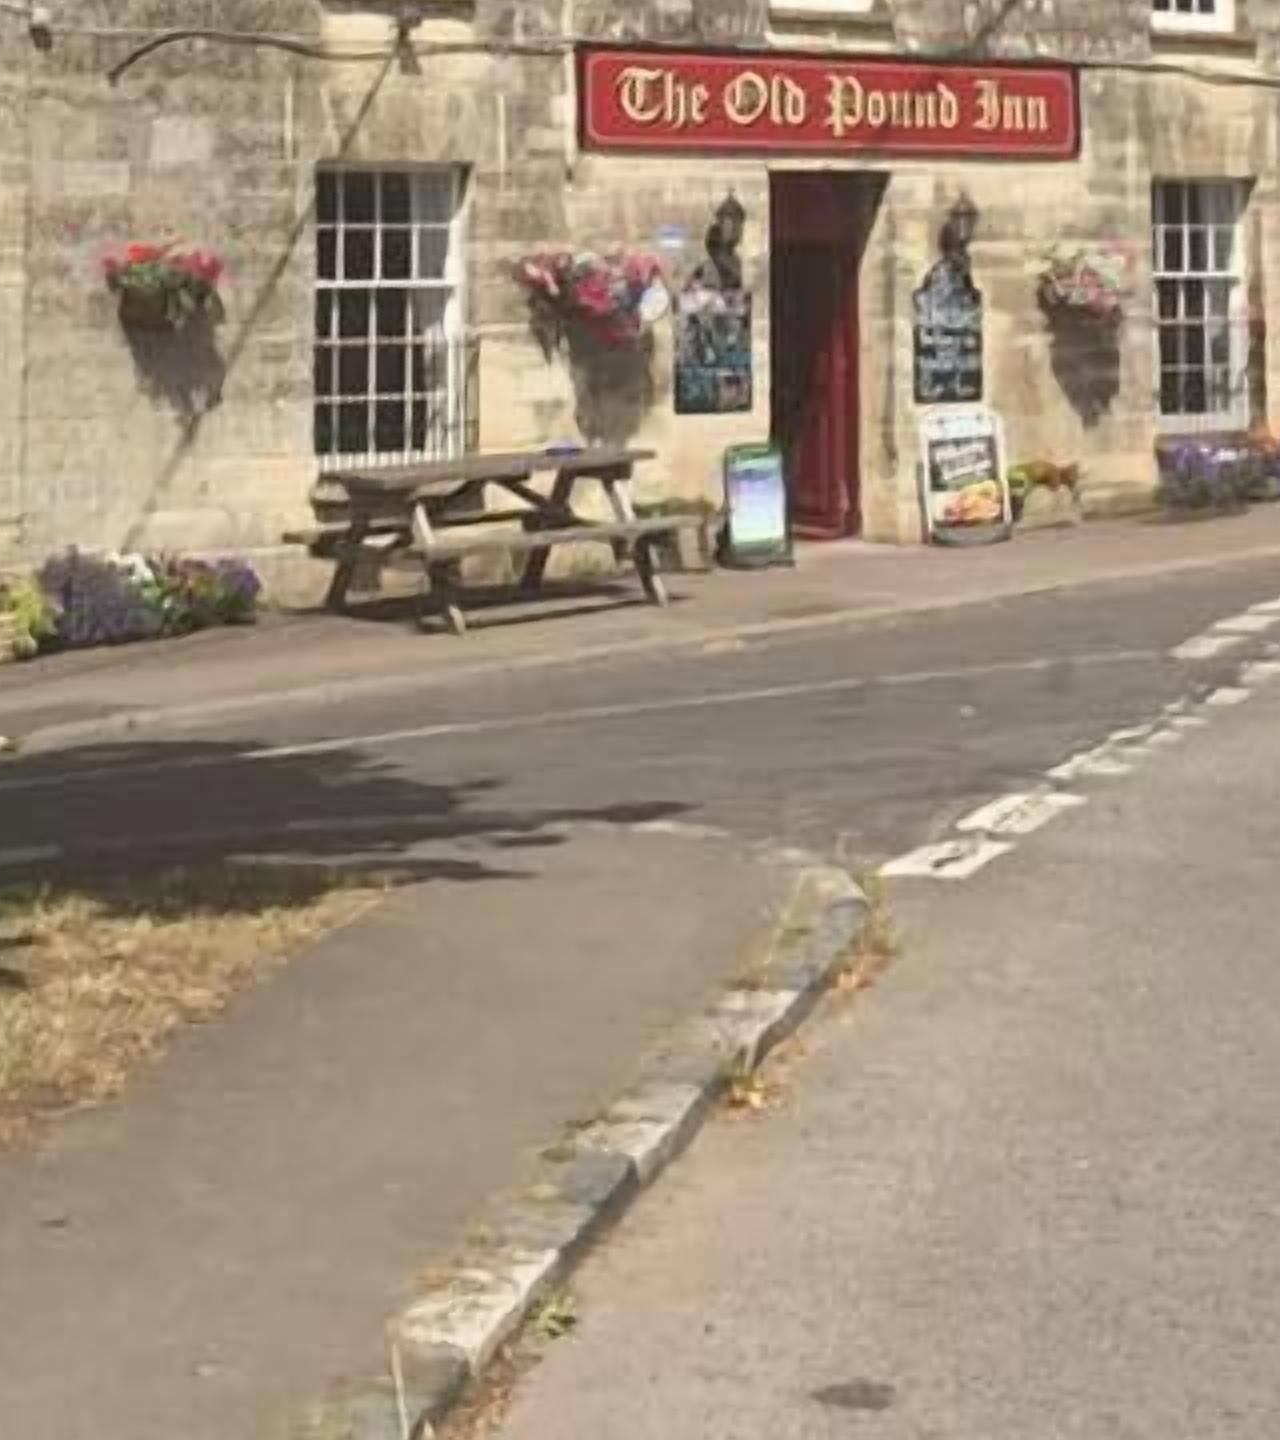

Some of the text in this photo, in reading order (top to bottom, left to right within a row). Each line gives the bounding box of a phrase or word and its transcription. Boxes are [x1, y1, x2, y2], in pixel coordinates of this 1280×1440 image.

[616, 66, 1048, 138] The Old Pound Inn
